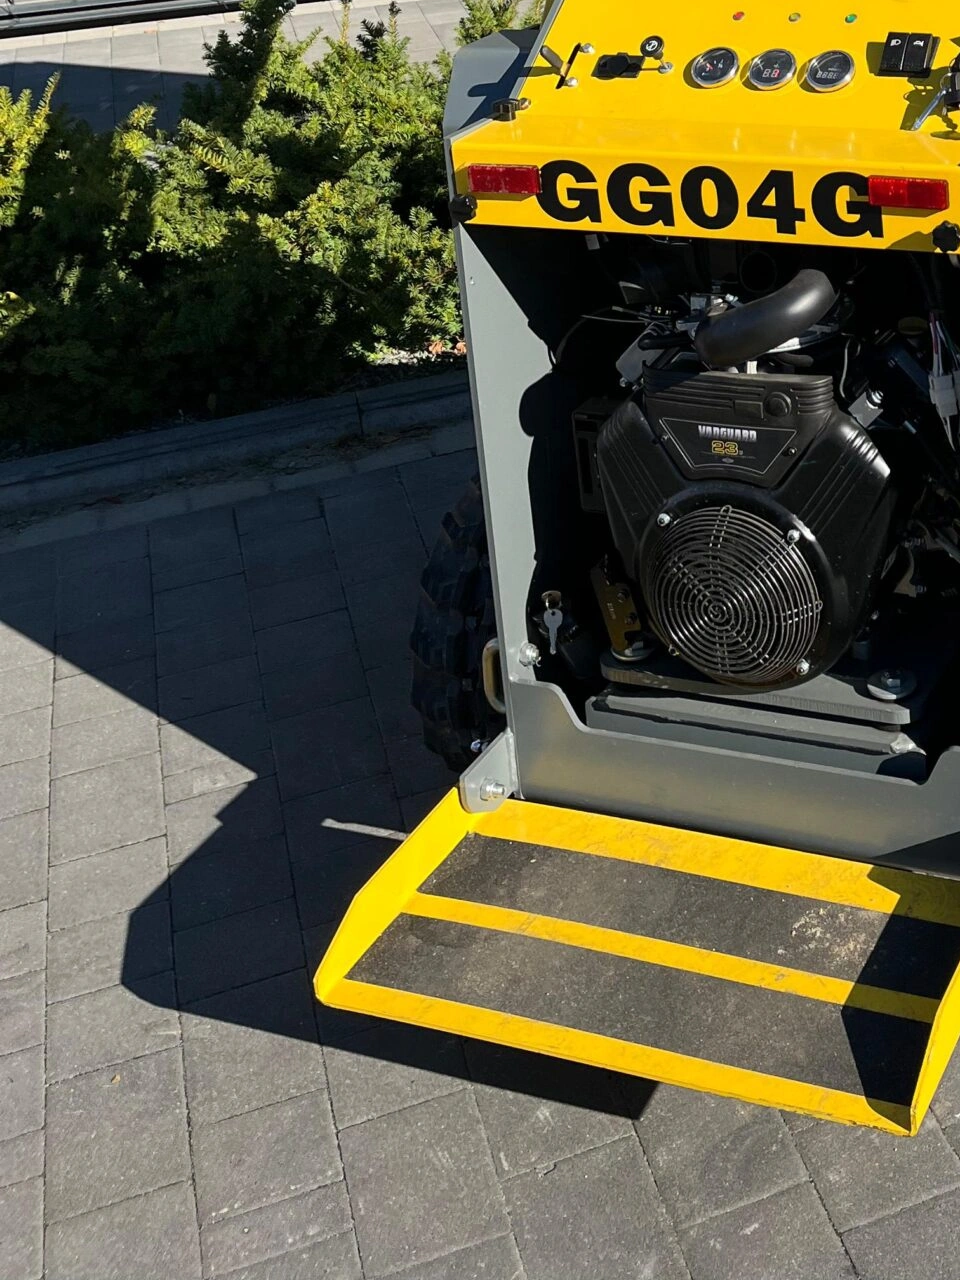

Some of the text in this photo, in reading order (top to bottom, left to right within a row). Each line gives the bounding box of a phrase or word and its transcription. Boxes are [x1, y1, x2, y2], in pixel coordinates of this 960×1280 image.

[535, 159, 885, 239] GG04G
[697, 424, 758, 443] VANGUARD
[711, 439, 739, 456] 23
